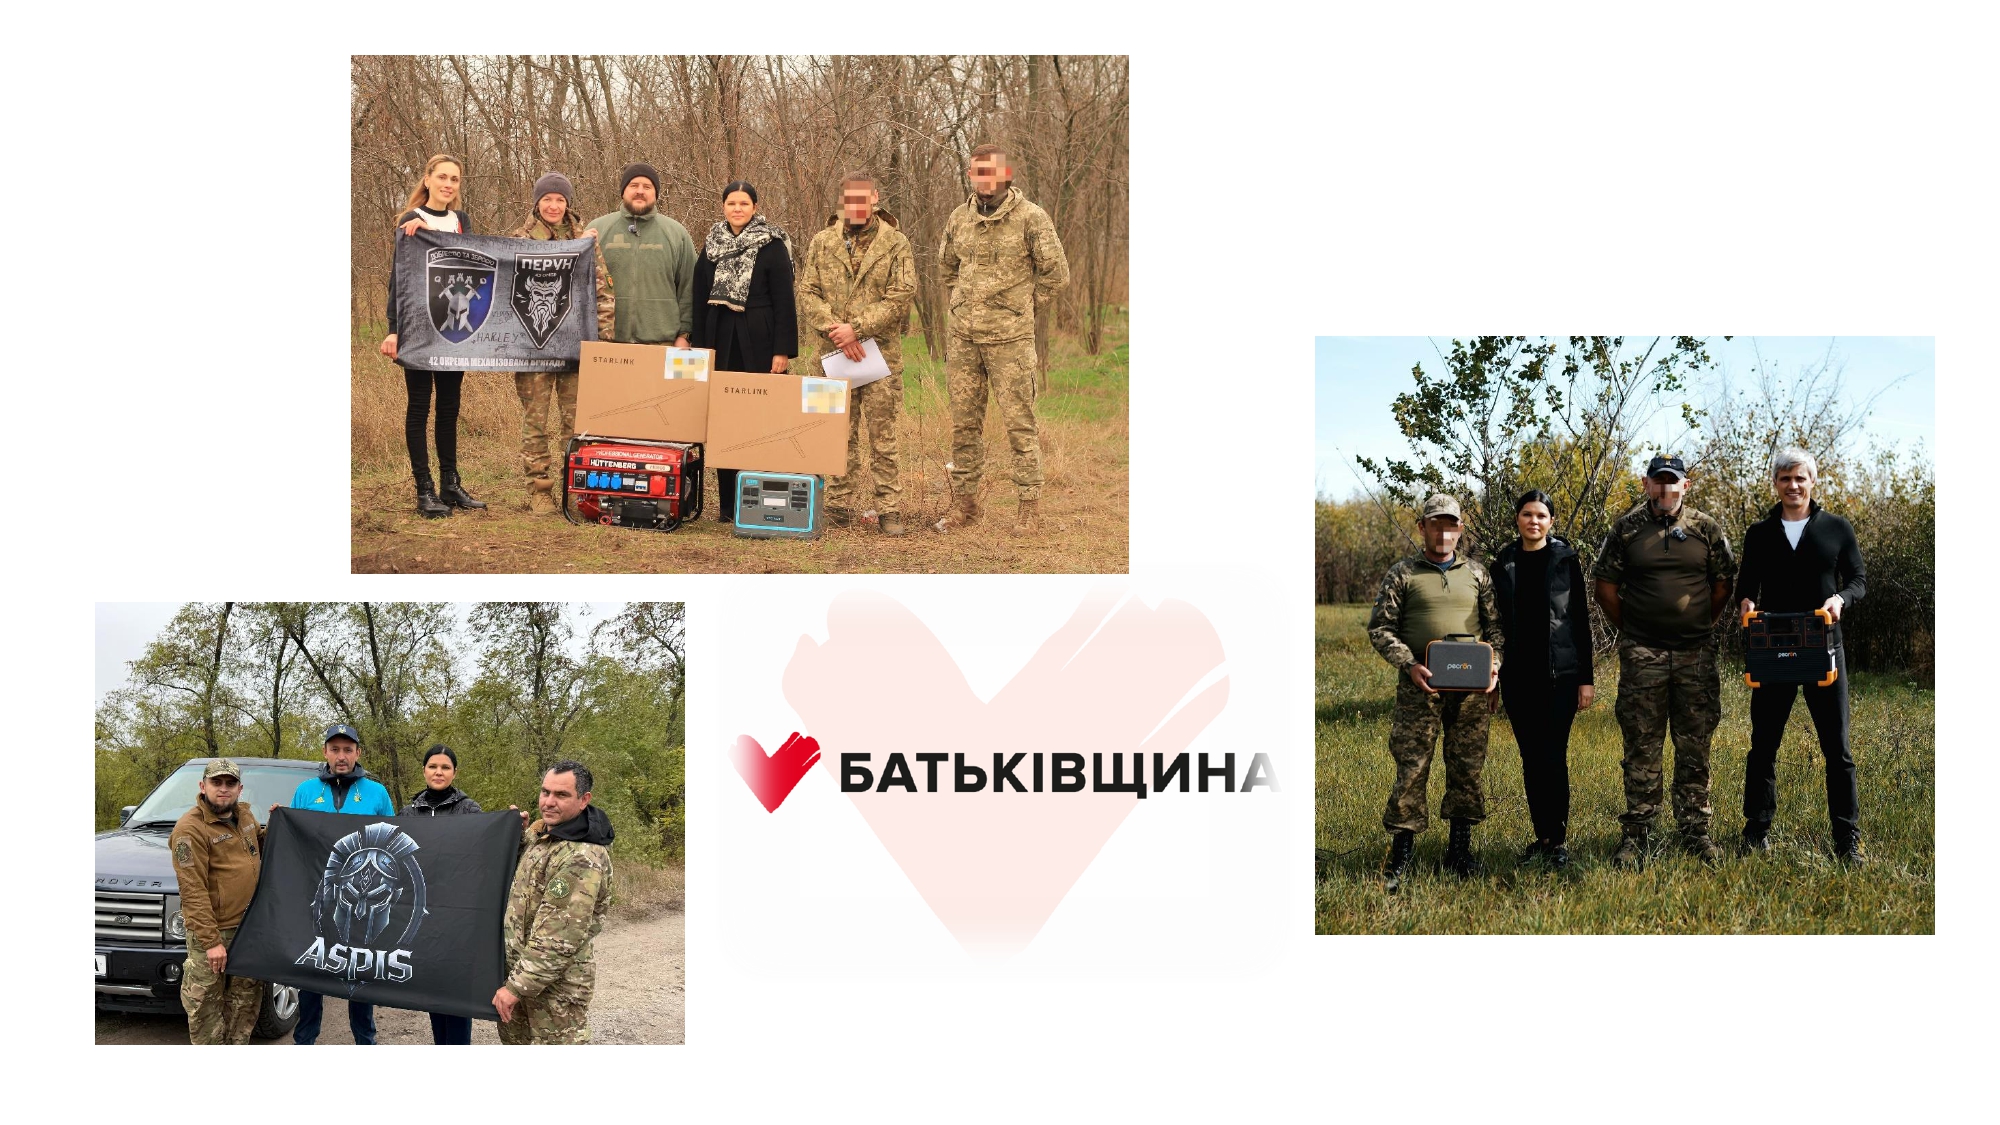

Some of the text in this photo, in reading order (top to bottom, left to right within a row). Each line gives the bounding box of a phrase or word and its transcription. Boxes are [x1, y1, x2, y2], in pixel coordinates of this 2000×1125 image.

[462, 251, 471, 259] ТА
[521, 258, 573, 271] ПЕРУН
[428, 356, 438, 366] 42
[439, 356, 470, 366] ОКРЕМА
[470, 357, 529, 367] МЕХАНІЗОВАНА
[593, 356, 635, 365] STARLINK
[724, 386, 768, 396] STARLINK
[596, 449, 664, 460] PROFESSIONAL GENERATOR
[590, 458, 637, 470] HÜTTENBERG
[1446, 662, 1473, 671] pecron
[293, 935, 413, 983] ASPIS
